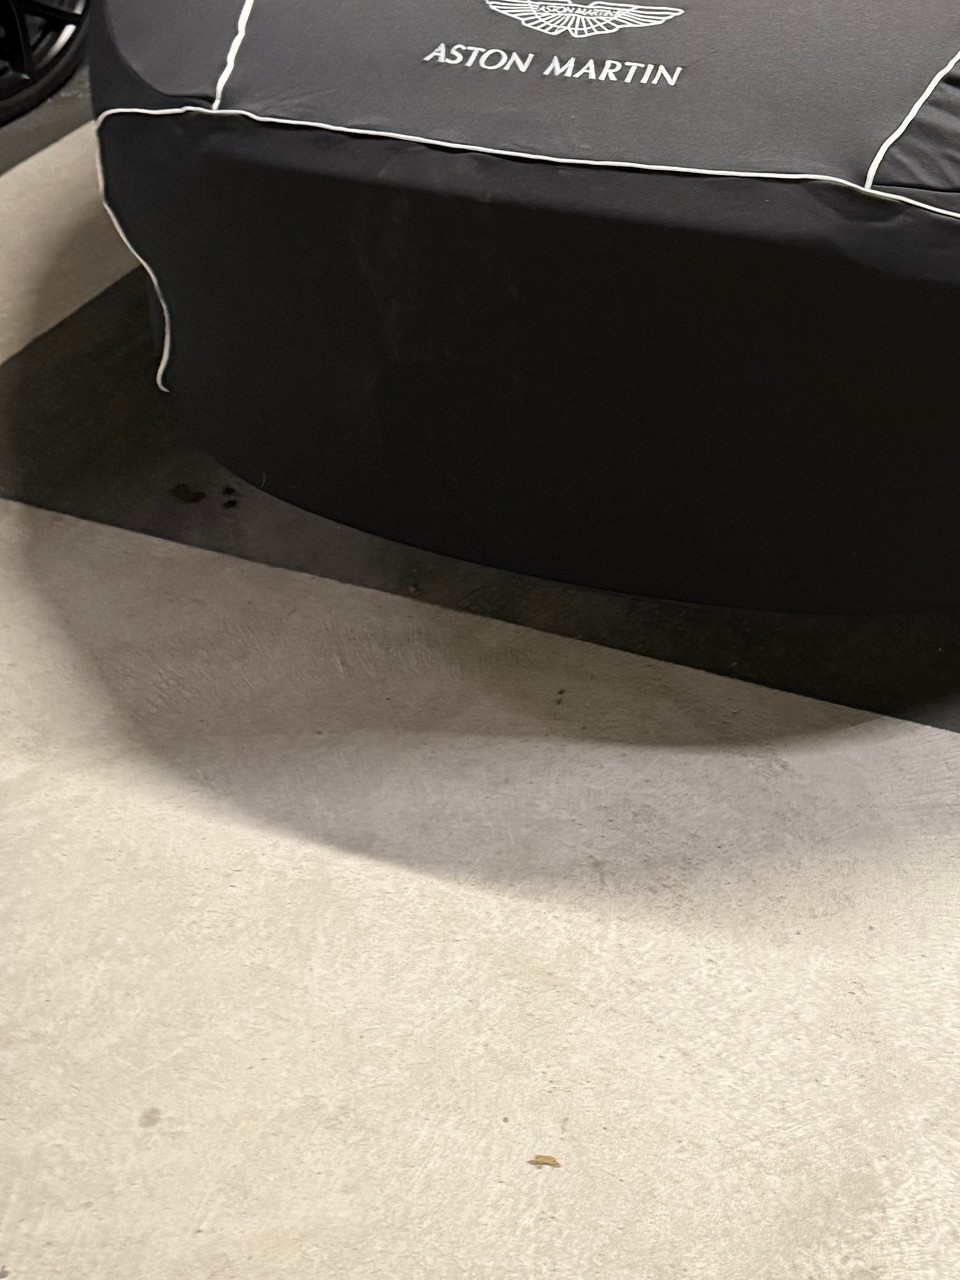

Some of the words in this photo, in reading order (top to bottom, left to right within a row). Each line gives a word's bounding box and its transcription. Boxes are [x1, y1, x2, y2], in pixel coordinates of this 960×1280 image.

[538, 5, 573, 14] ASTON
[575, 7, 615, 17] MARTIN
[423, 42, 535, 73] ASTON
[543, 55, 683, 86] MARTIN
